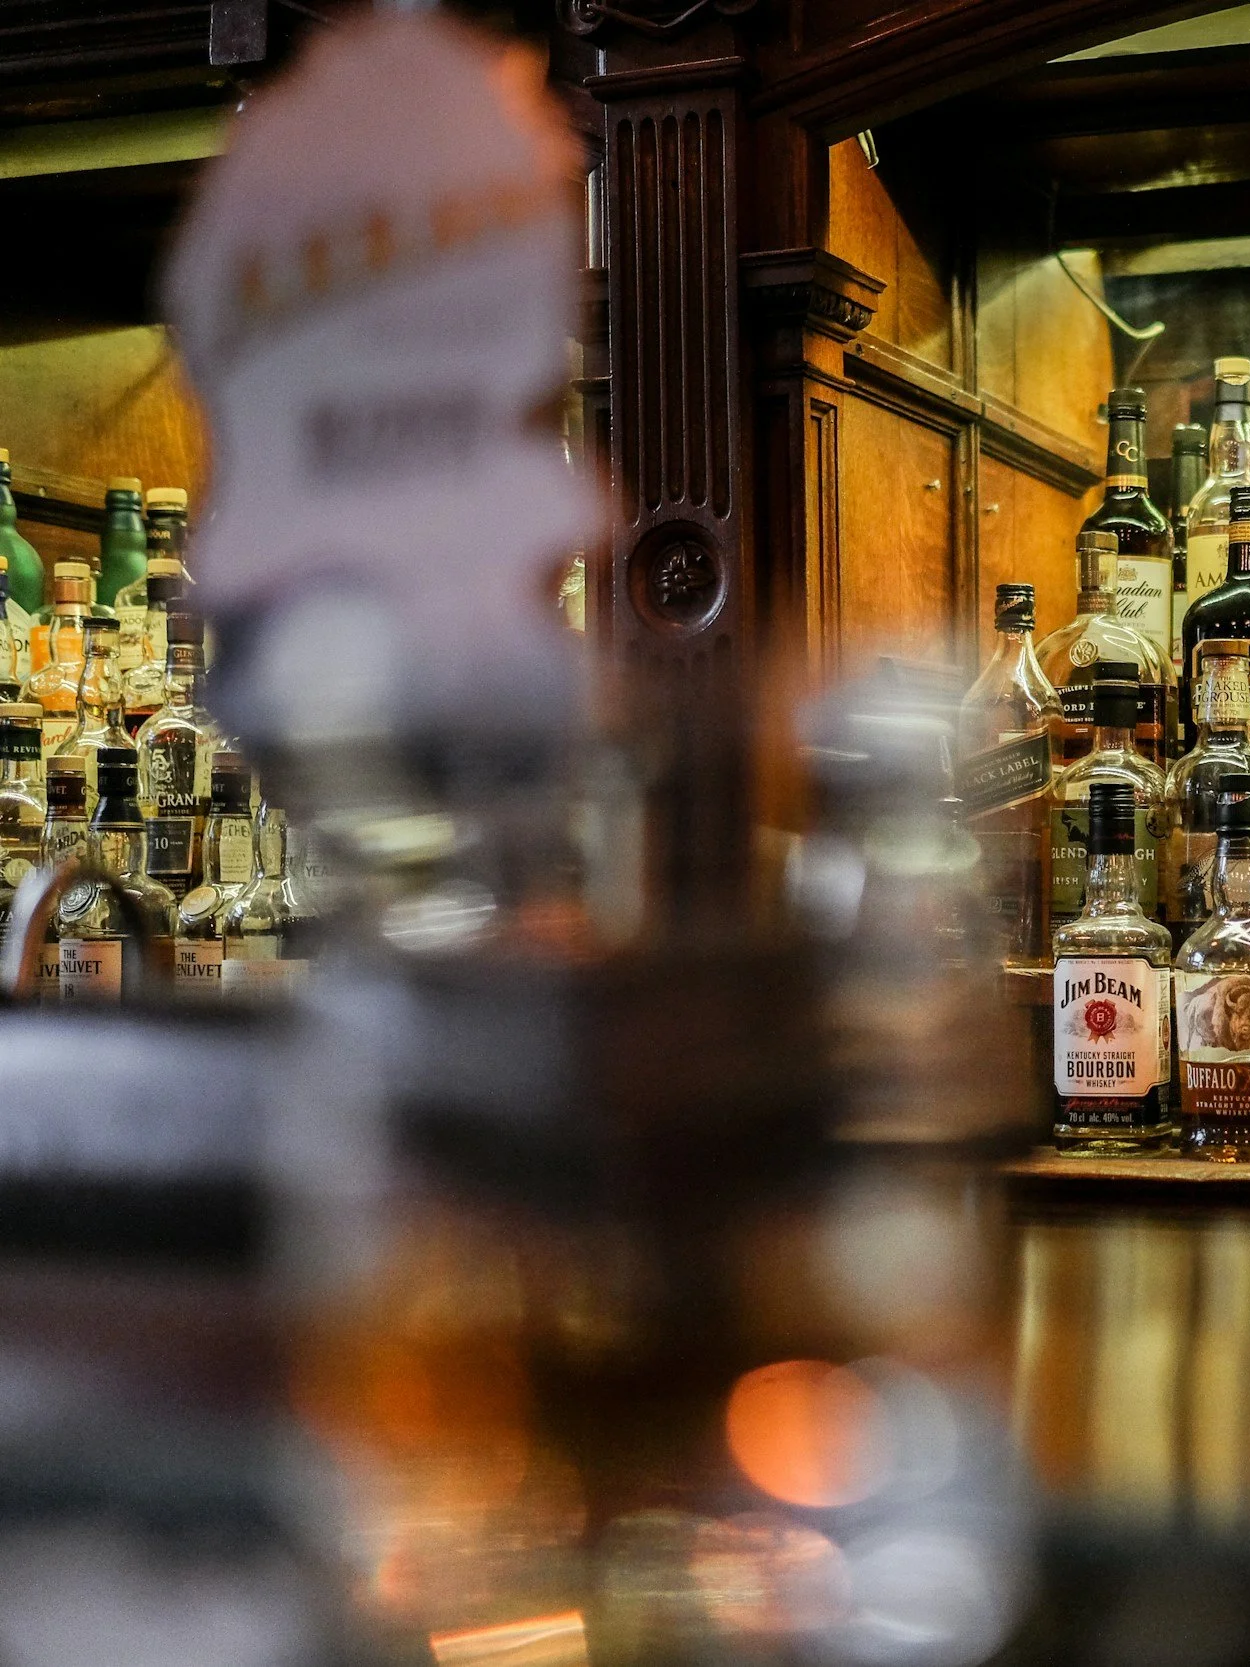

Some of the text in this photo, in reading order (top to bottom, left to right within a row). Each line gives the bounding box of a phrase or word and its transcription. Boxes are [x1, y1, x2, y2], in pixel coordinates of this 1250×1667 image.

[1116, 580, 1162, 598] nadian
[1058, 685, 1089, 695] STILLER'S
[1000, 755, 1039, 776] LABEL
[157, 791, 201, 808] GRANT
[154, 837, 169, 850] 10
[63, 949, 77, 959] THE
[180, 952, 197, 963] THE
[60, 960, 103, 975] ENLIVET
[1061, 972, 1143, 1010] JIM BEAM
[1067, 1051, 1136, 1060] KENTUCKY STRAIGHT
[1067, 1061, 1136, 1078] BOURBON
[1186, 1063, 1237, 1090] BUFFALO
[1086, 1079, 1116, 1088] WHISKEY
[1069, 1112, 1078, 1123] 70
[1102, 1112, 1120, 1123] 40%
